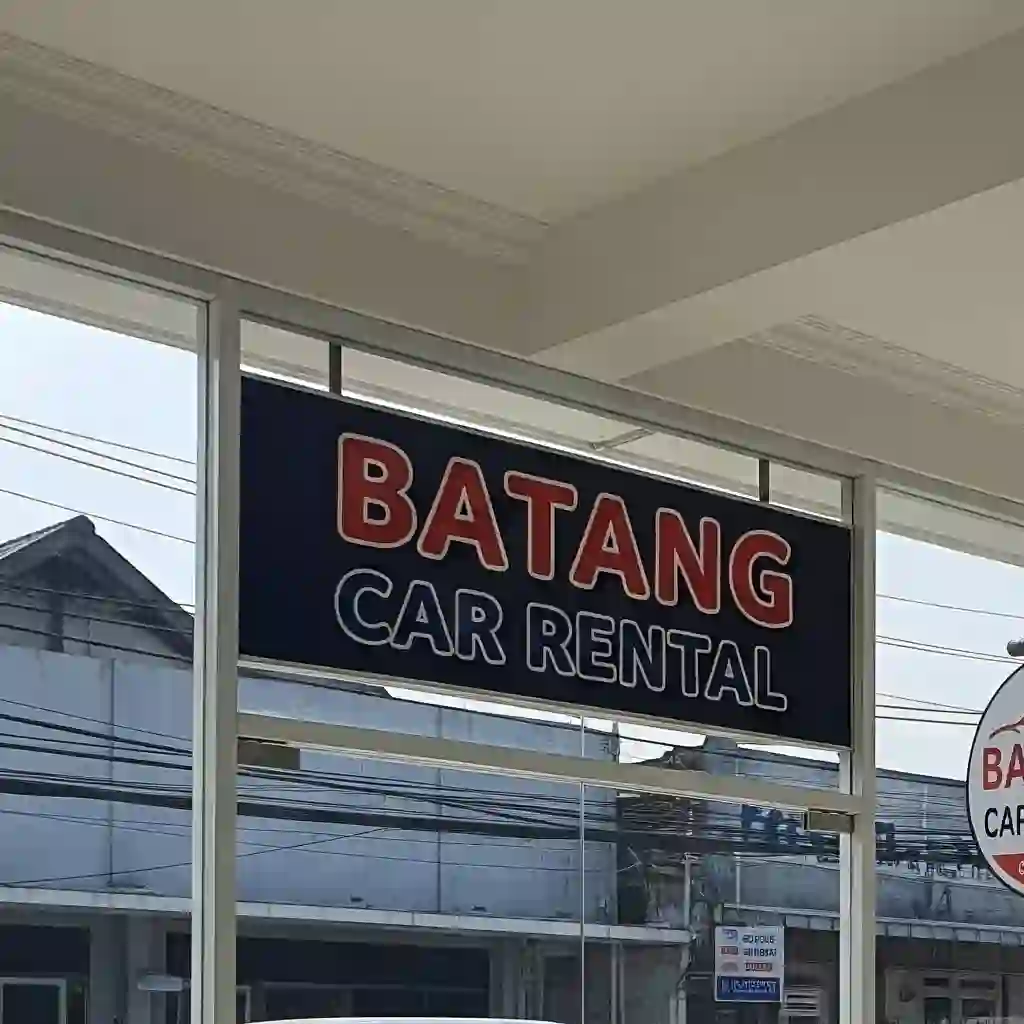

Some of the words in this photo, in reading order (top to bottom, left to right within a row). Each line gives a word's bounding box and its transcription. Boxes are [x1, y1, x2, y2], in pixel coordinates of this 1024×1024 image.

[336, 432, 793, 628] BATANG
[334, 567, 506, 665] CAR
[525, 602, 788, 712] RENTAL
